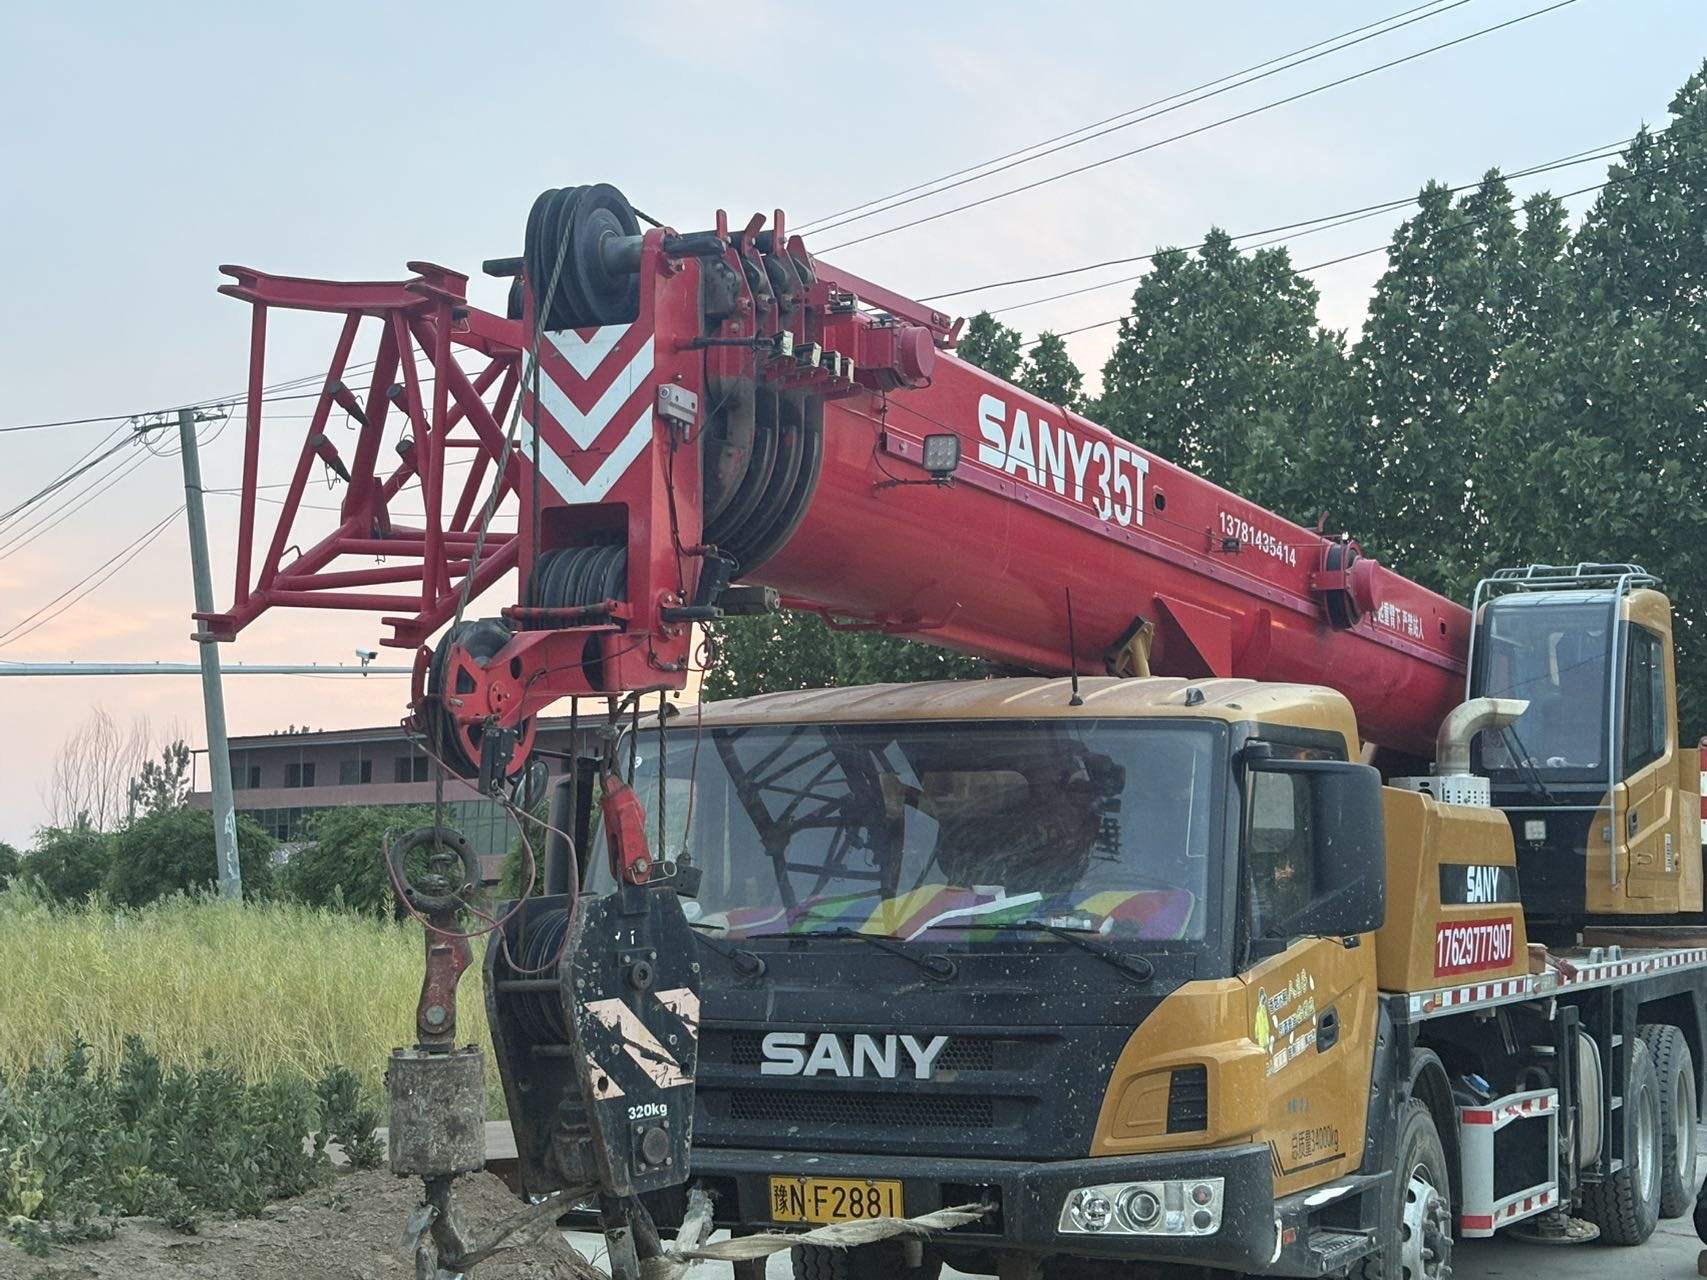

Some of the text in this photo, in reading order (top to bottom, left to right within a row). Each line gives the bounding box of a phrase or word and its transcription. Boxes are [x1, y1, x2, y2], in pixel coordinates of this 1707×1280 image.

[1220, 511, 1296, 567] 13781435414
[1466, 866, 1499, 902] SANY
[1437, 923, 1512, 968] 17629777907
[761, 1032, 949, 1079] SANY
[628, 1102, 667, 1120] 320kg
